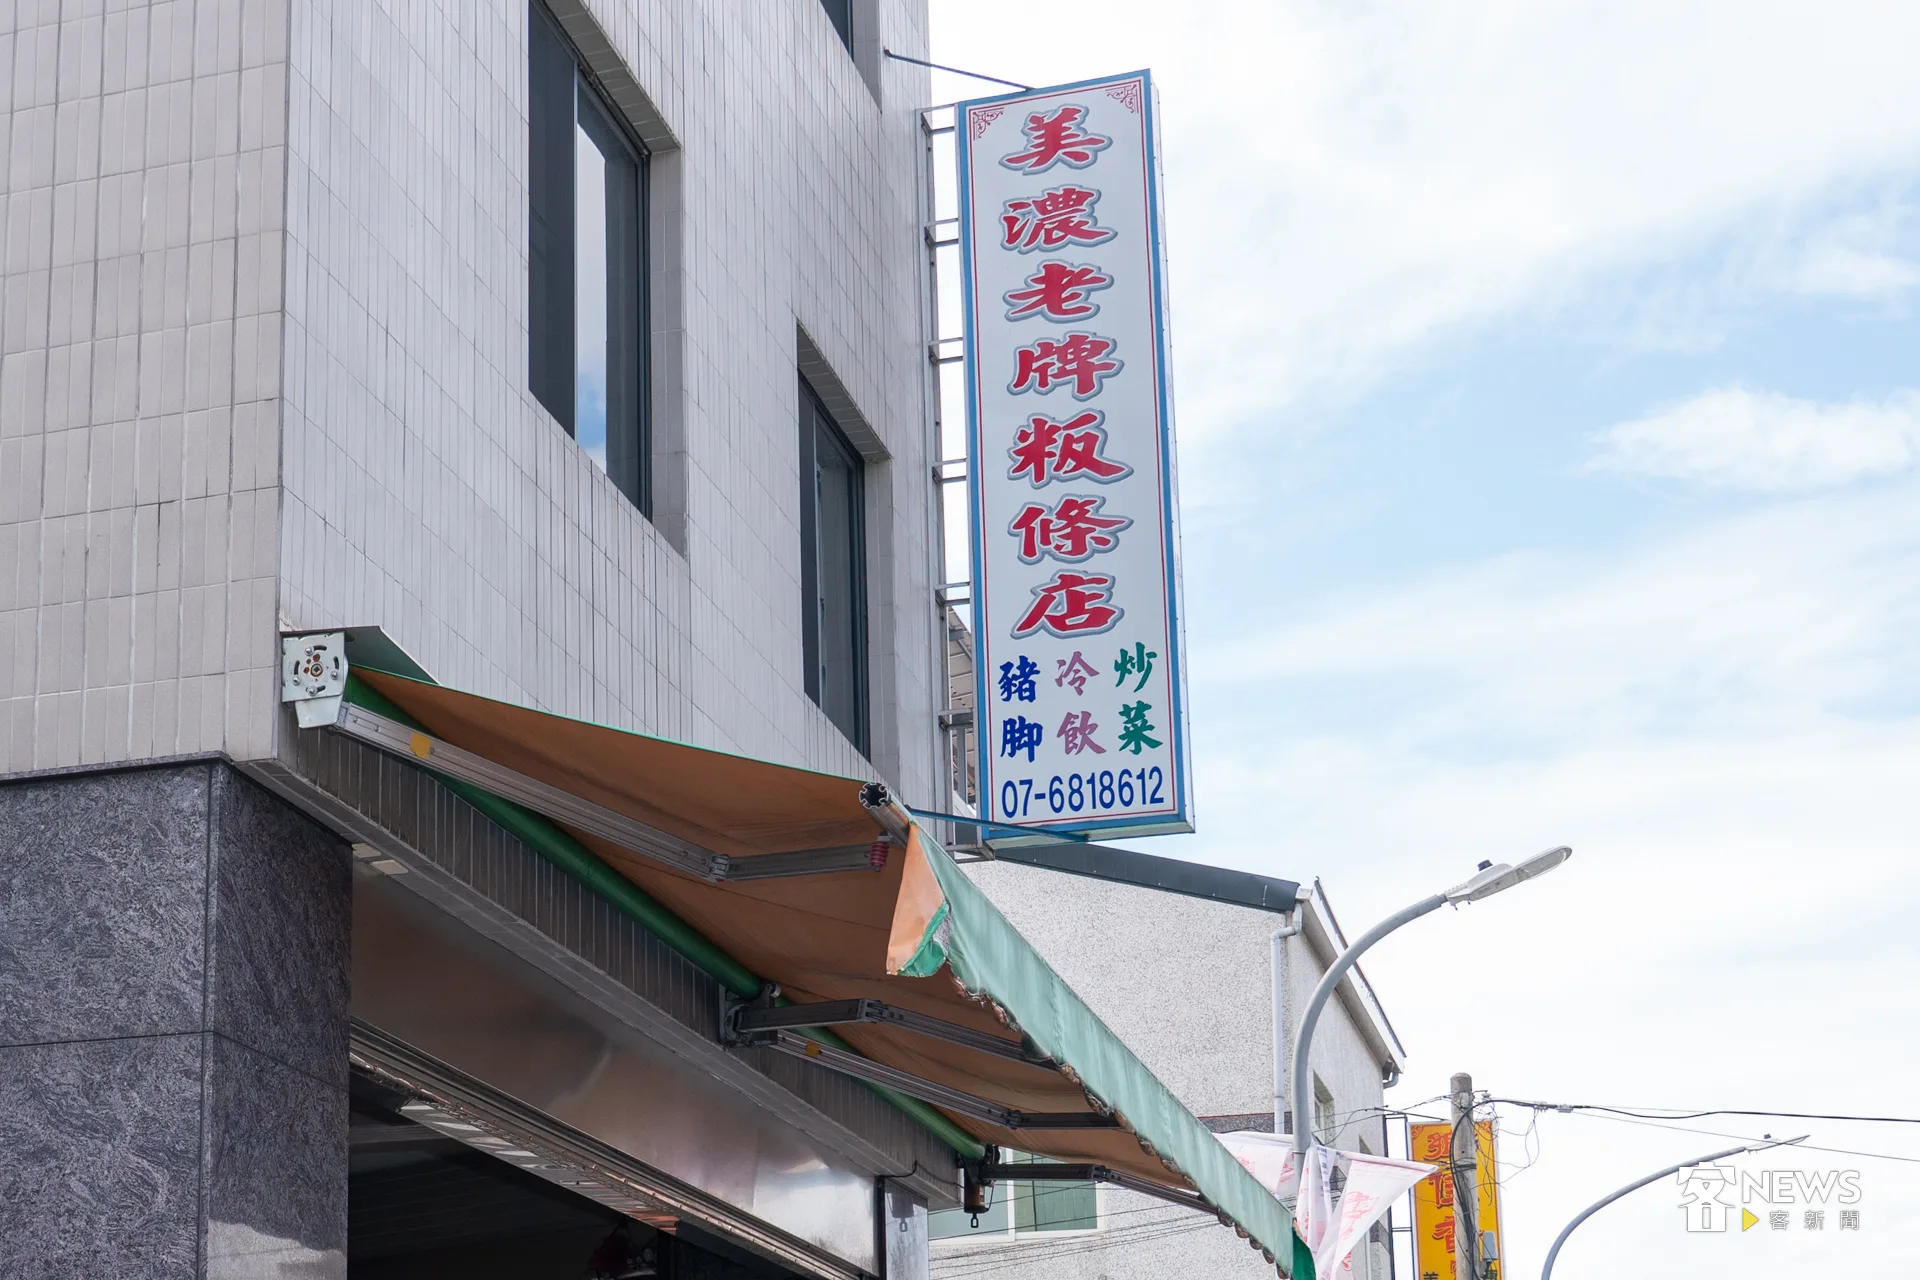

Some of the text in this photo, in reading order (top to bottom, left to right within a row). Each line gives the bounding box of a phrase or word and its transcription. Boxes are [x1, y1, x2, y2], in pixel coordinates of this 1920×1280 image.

[998, 104, 1134, 640] 美濃老牌粄條店
[1055, 650, 1107, 755] 冷飲
[1113, 641, 1164, 756] 炒菜
[1001, 765, 1165, 818] 07-6818612
